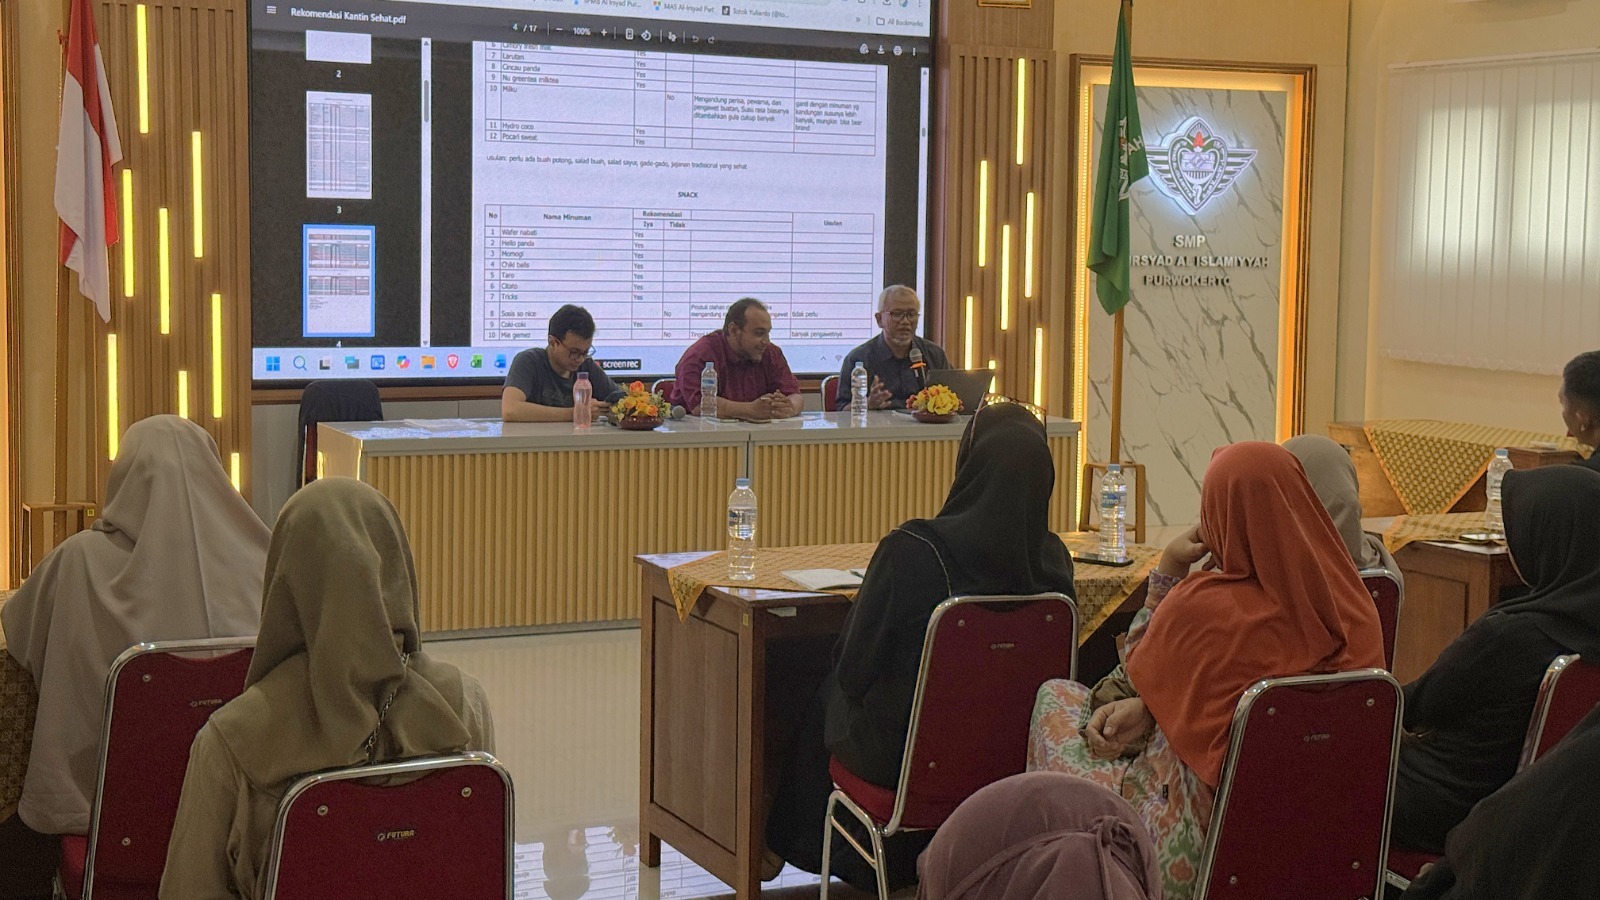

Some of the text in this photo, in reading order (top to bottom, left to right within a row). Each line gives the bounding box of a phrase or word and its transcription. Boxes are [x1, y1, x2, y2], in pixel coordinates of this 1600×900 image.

[290, 7, 407, 25] Rekomendasi Kantin Sehat.pdf
[896, 19, 923, 27] Bookmarks
[573, 27, 591, 36] 100%
[523, 65, 541, 73] panda
[336, 70, 342, 78] 2
[502, 122, 520, 131] Hydro
[509, 155, 523, 163] perlu
[574, 157, 589, 165] salad
[337, 206, 342, 214] 3
[642, 210, 682, 218] Rekomendasi
[543, 213, 562, 221] Nama
[643, 221, 653, 229] Iya
[517, 240, 535, 248] panda
[1174, 234, 1206, 248] SMP
[501, 250, 524, 259] Momogi
[1177, 255, 1193, 267] AL
[1196, 255, 1268, 267] ISLAMIYYAH
[1144, 275, 1231, 287] PURWOKERTO
[810, 331, 842, 339] pengawetnya
